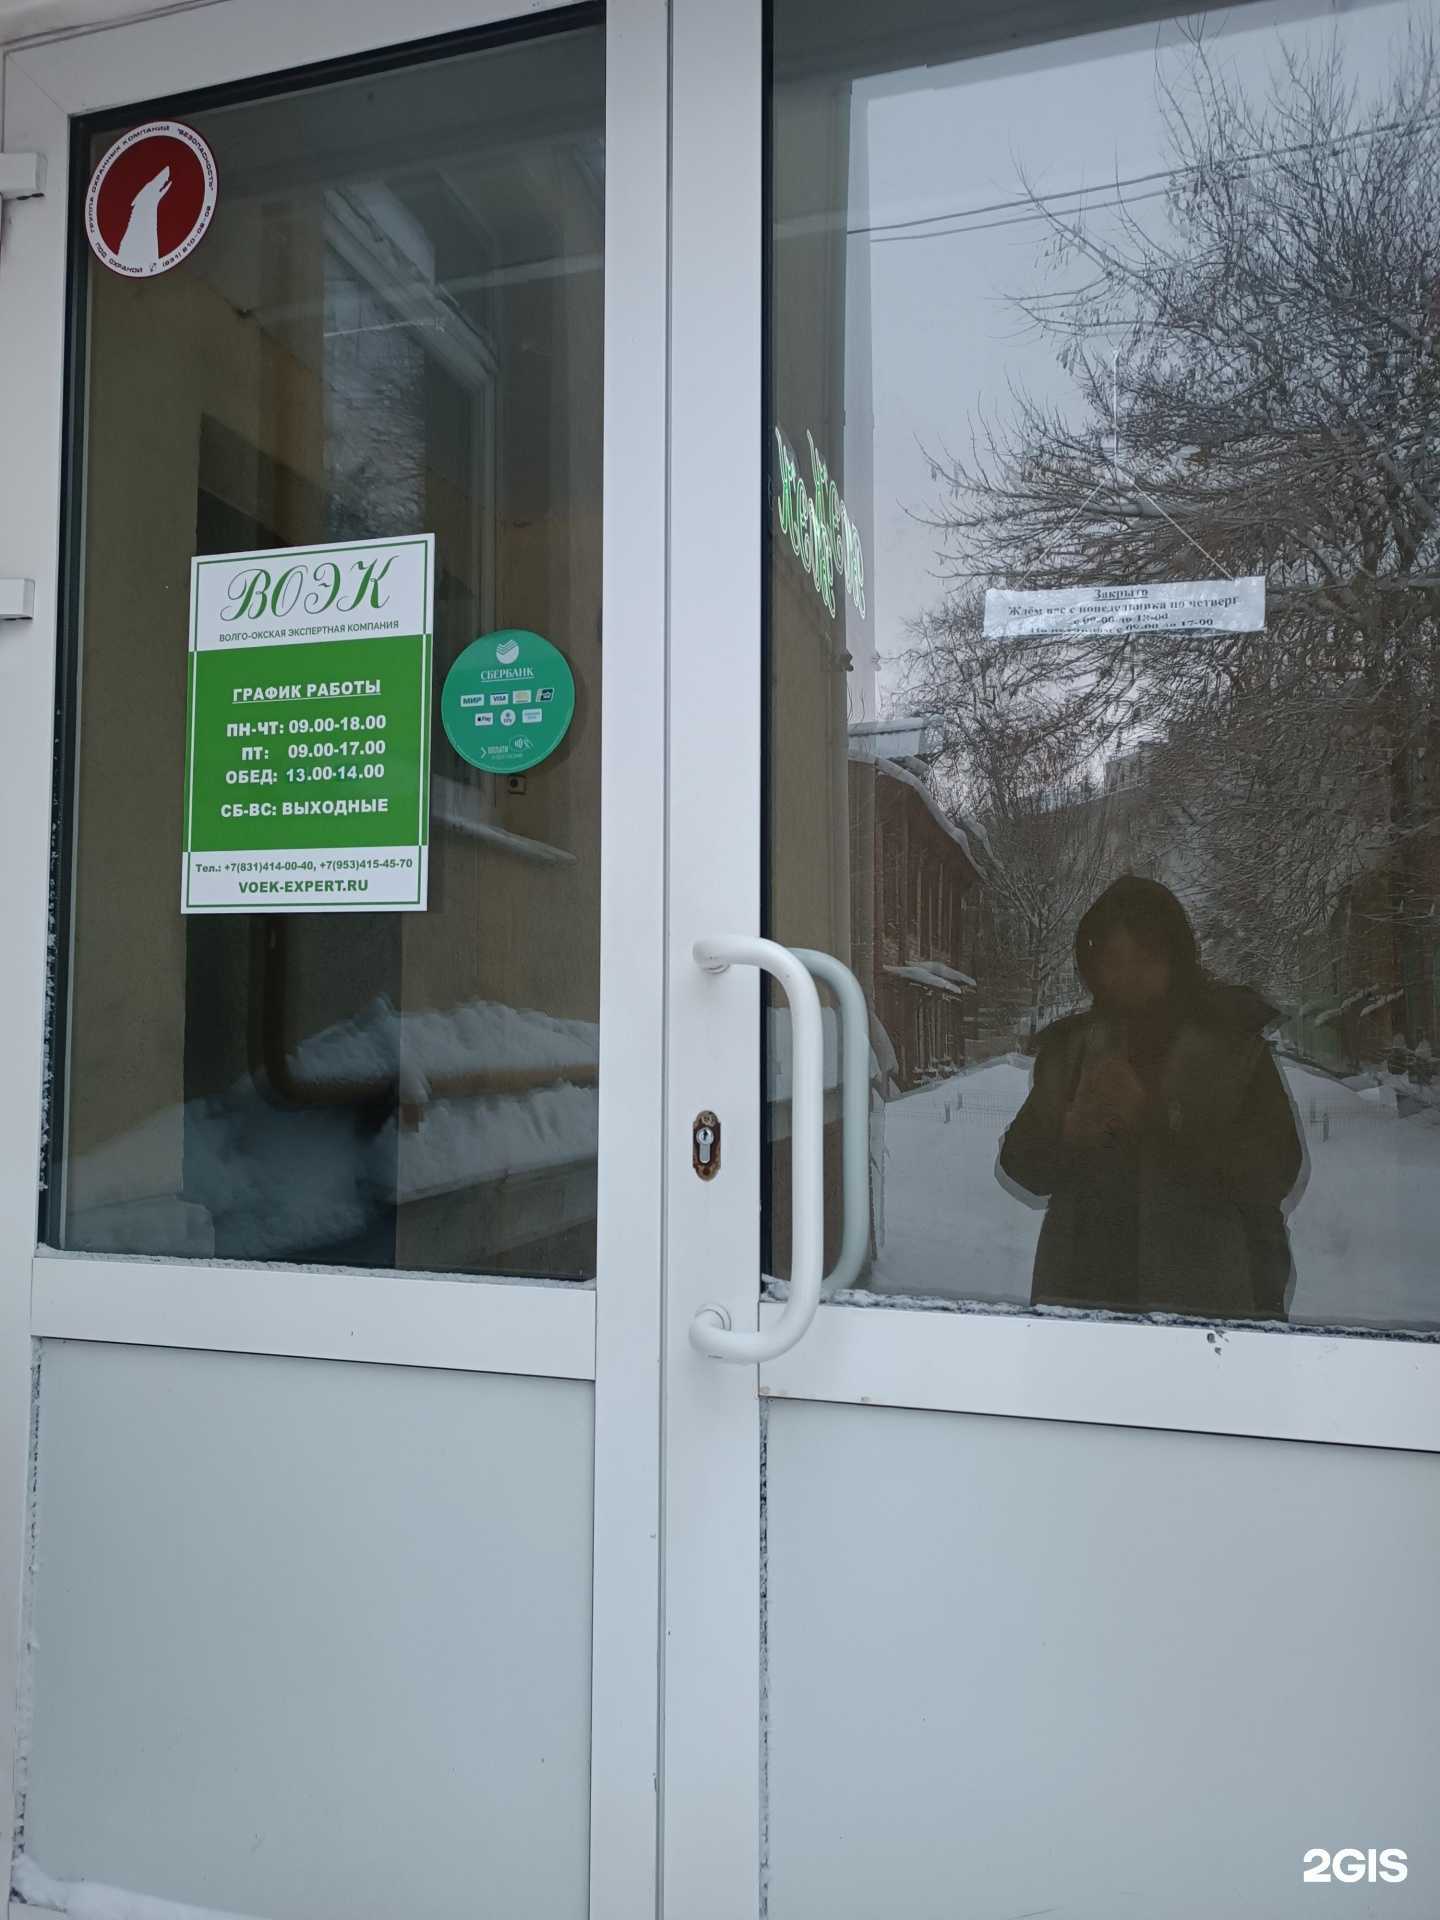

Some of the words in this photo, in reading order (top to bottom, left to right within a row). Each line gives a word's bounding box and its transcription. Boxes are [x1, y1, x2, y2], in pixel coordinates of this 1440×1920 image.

[220, 555, 399, 622] ВОЭК
[1095, 588, 1149, 601] Закрыто
[1189, 595, 1239, 608] четверг
[219, 629, 286, 642] ВОЛГО-ОКСКАЯ
[288, 624, 346, 637] ЭКСПЕРТНАЯ
[347, 620, 399, 632] КОМПАНИЯ
[480, 667, 535, 682] СБЕРБАНК
[232, 685, 302, 703] ГРАФИК
[306, 679, 381, 698] РАБОТЫ
[226, 721, 285, 737] ПН-ЧТ:
[288, 715, 387, 734] 09.00-18.00
[241, 746, 270, 761] ПТ:
[287, 740, 386, 759] 09.00-17.00
[225, 769, 278, 785] ОБЕД:
[286, 764, 385, 783] 13.00-14.00
[220, 803, 277, 818] СБ-ВС:
[282, 798, 389, 816] ВЫХОДНЫЕ
[195, 863, 222, 873] Тел.:
[224, 861, 317, 873] +7(831)414-00-40,
[319, 858, 413, 871] +7(953)415-45-70
[238, 879, 369, 894] VOEK-EXPERT.RU
